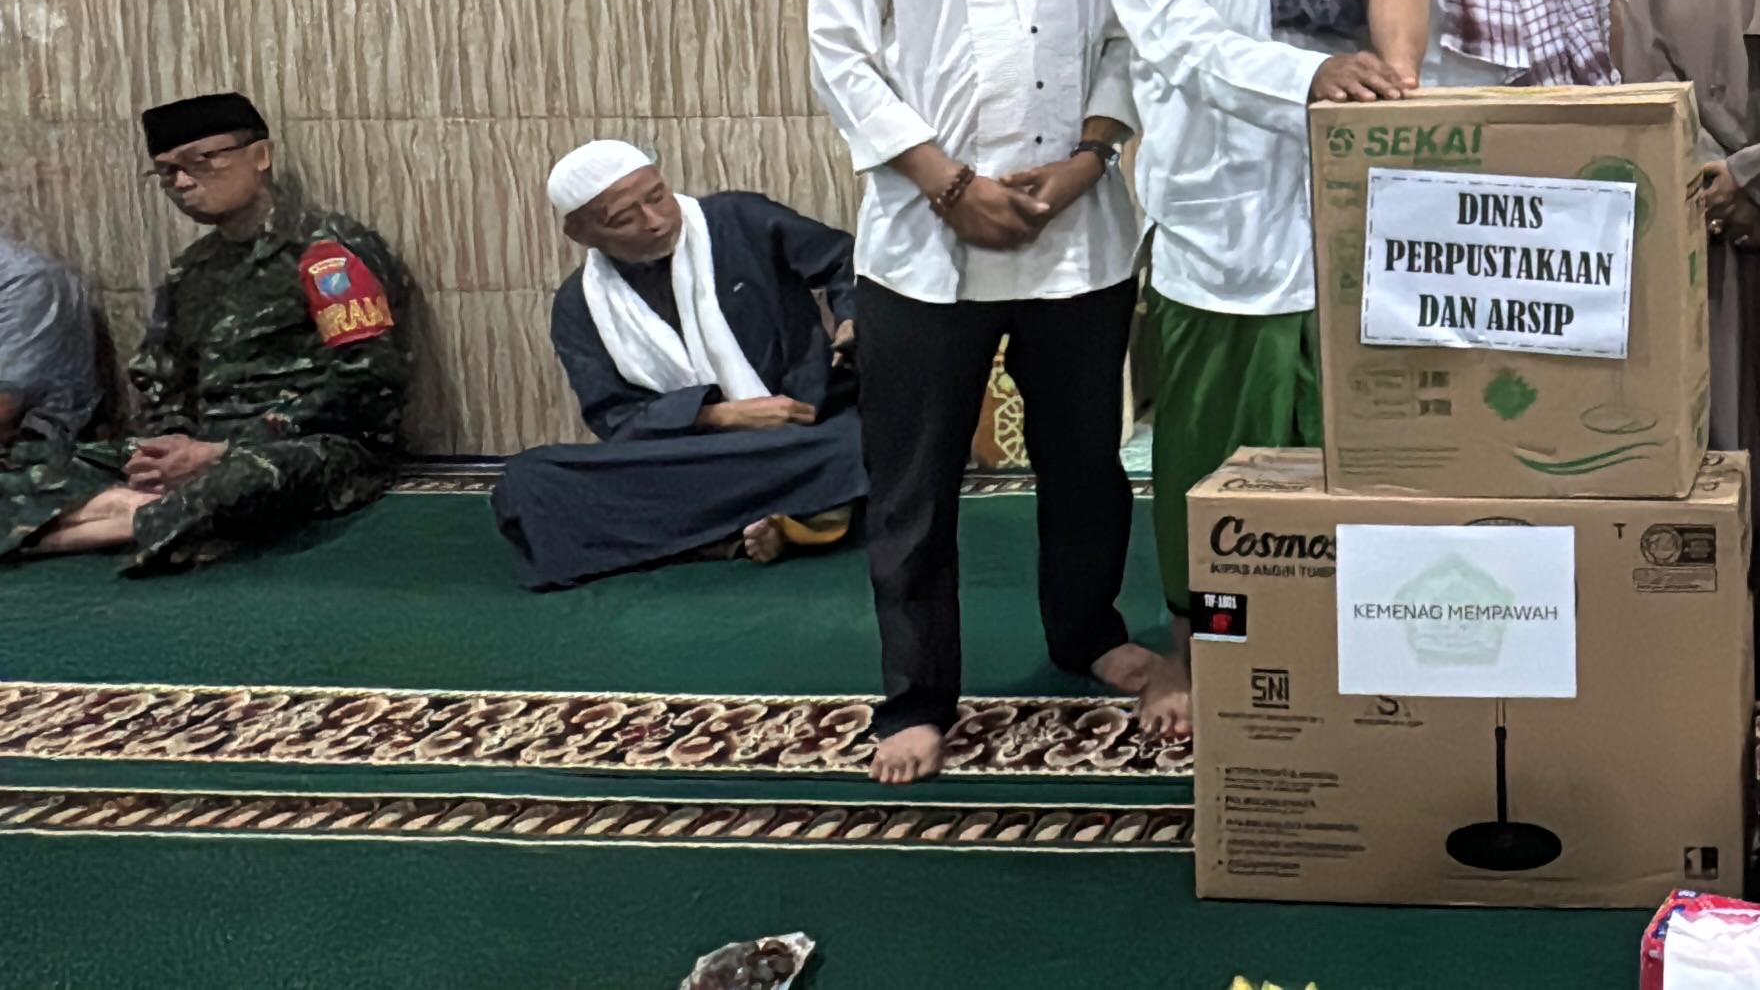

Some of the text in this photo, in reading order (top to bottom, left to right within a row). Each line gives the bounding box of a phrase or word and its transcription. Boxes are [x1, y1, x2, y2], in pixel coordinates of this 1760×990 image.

[1363, 123, 1484, 158] SEKAI
[1456, 191, 1544, 230] DINAS
[1384, 238, 1615, 287] PERPUSTAKAAN
[1416, 293, 1575, 337] DAN ARSIP
[1352, 603, 1559, 622] KEMENAG MEMPAWAH
[1251, 674, 1291, 702] SNI
